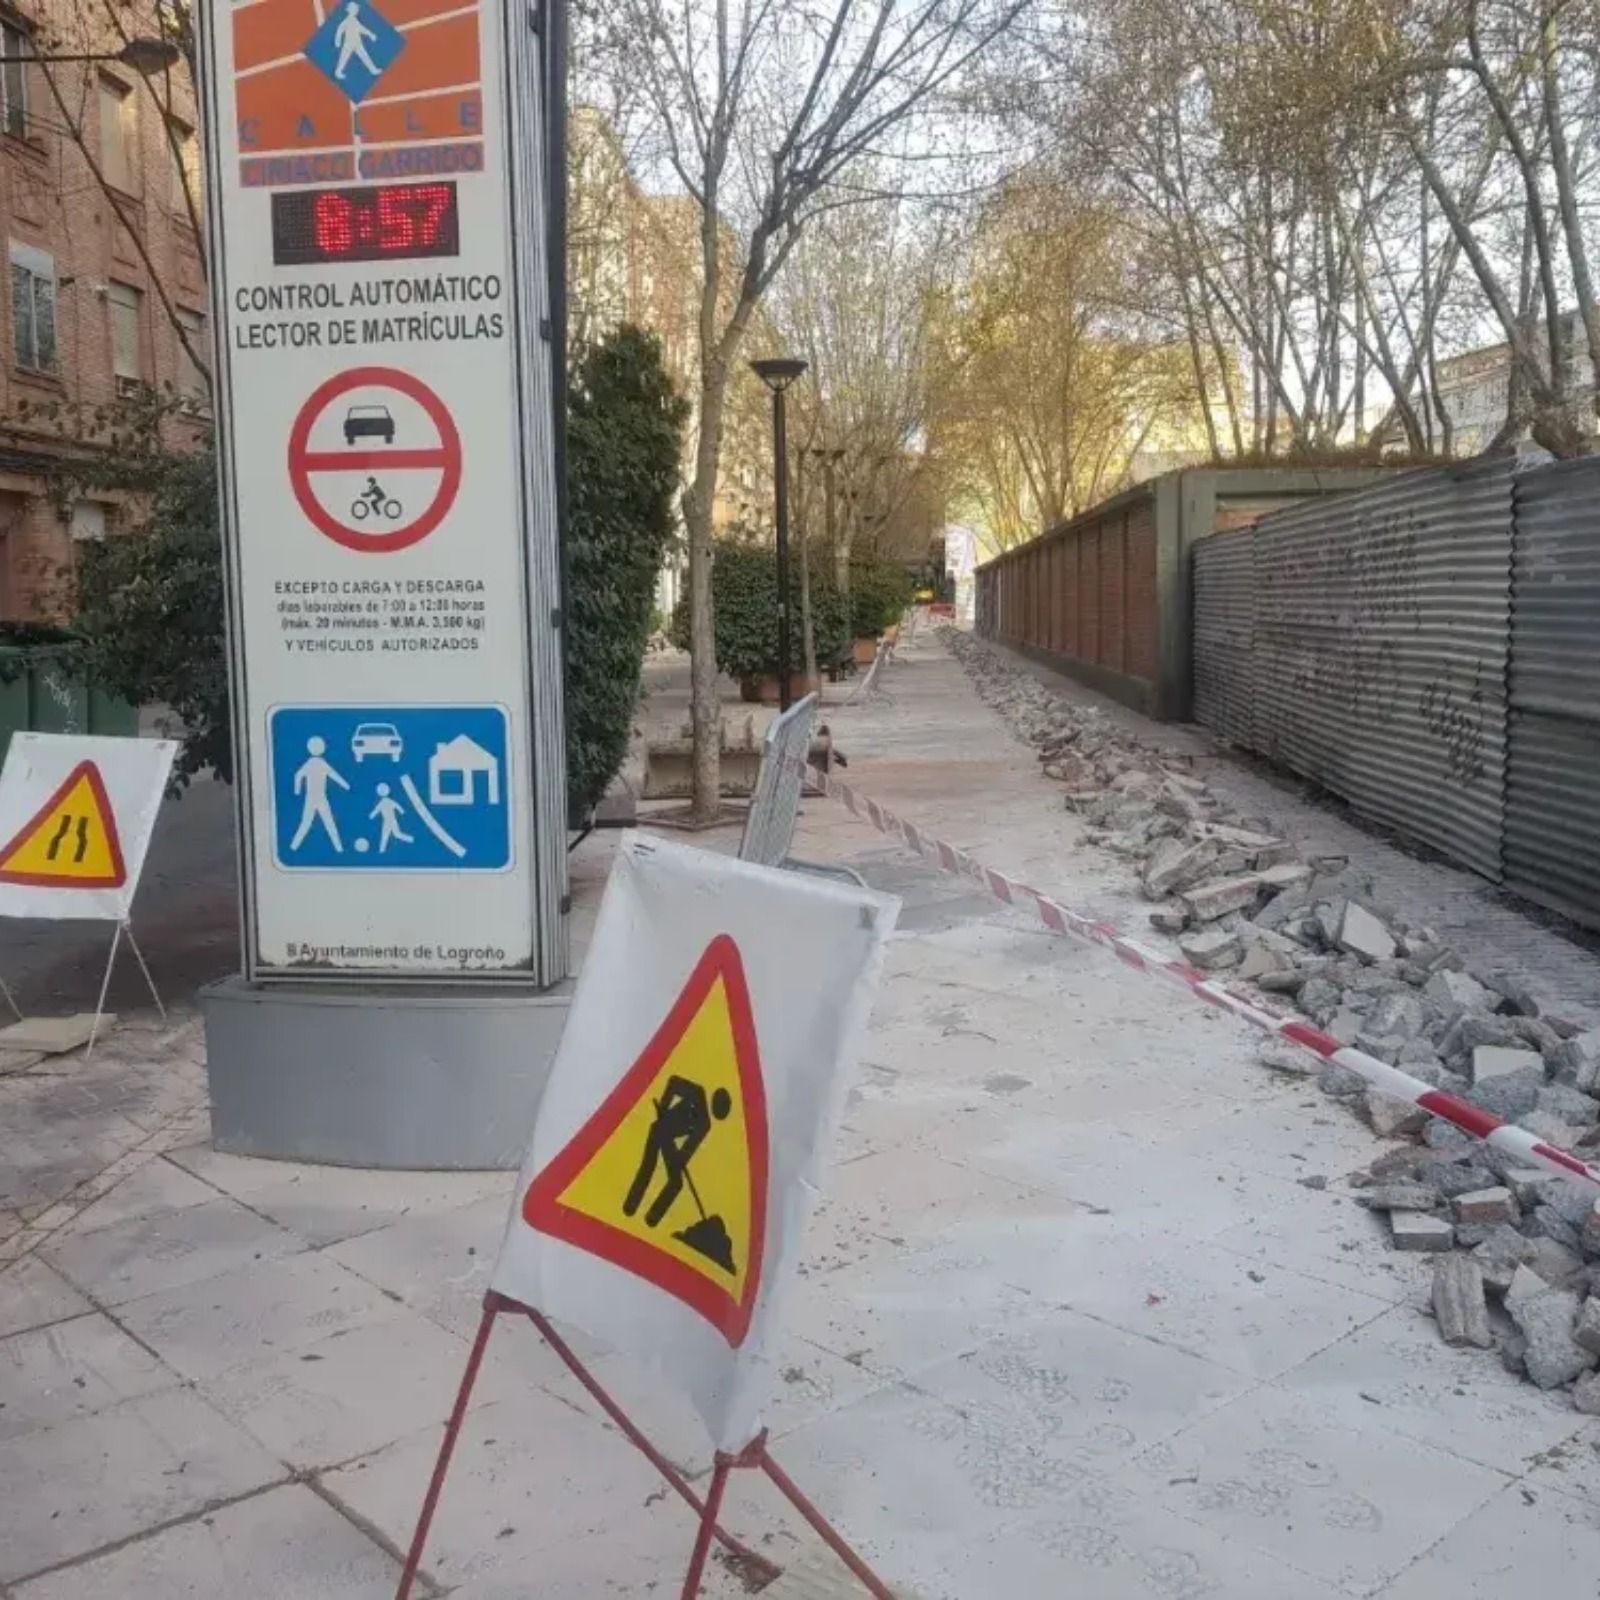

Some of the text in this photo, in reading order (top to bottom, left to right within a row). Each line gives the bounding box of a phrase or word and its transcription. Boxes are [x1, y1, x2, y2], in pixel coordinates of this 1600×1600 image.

[239, 102, 479, 143] CALLE
[358, 143, 481, 178] GARRIDO
[236, 273, 501, 312] CONTROL AUTOMÁTICO
[236, 311, 504, 349] LECTOR DE MATRÍCULAS
[275, 580, 485, 594] EXCEPTO CARGA Y DESCARGA
[304, 599, 363, 613] laborables
[366, 600, 379, 612] de
[409, 602, 416, 611] a
[452, 600, 485, 611] horas
[332, 616, 379, 628] minutos
[285, 637, 479, 651] Y VEHÍCULOS AUTORIZADOS
[301, 943, 505, 963] Ayuntamiento de Logroño
